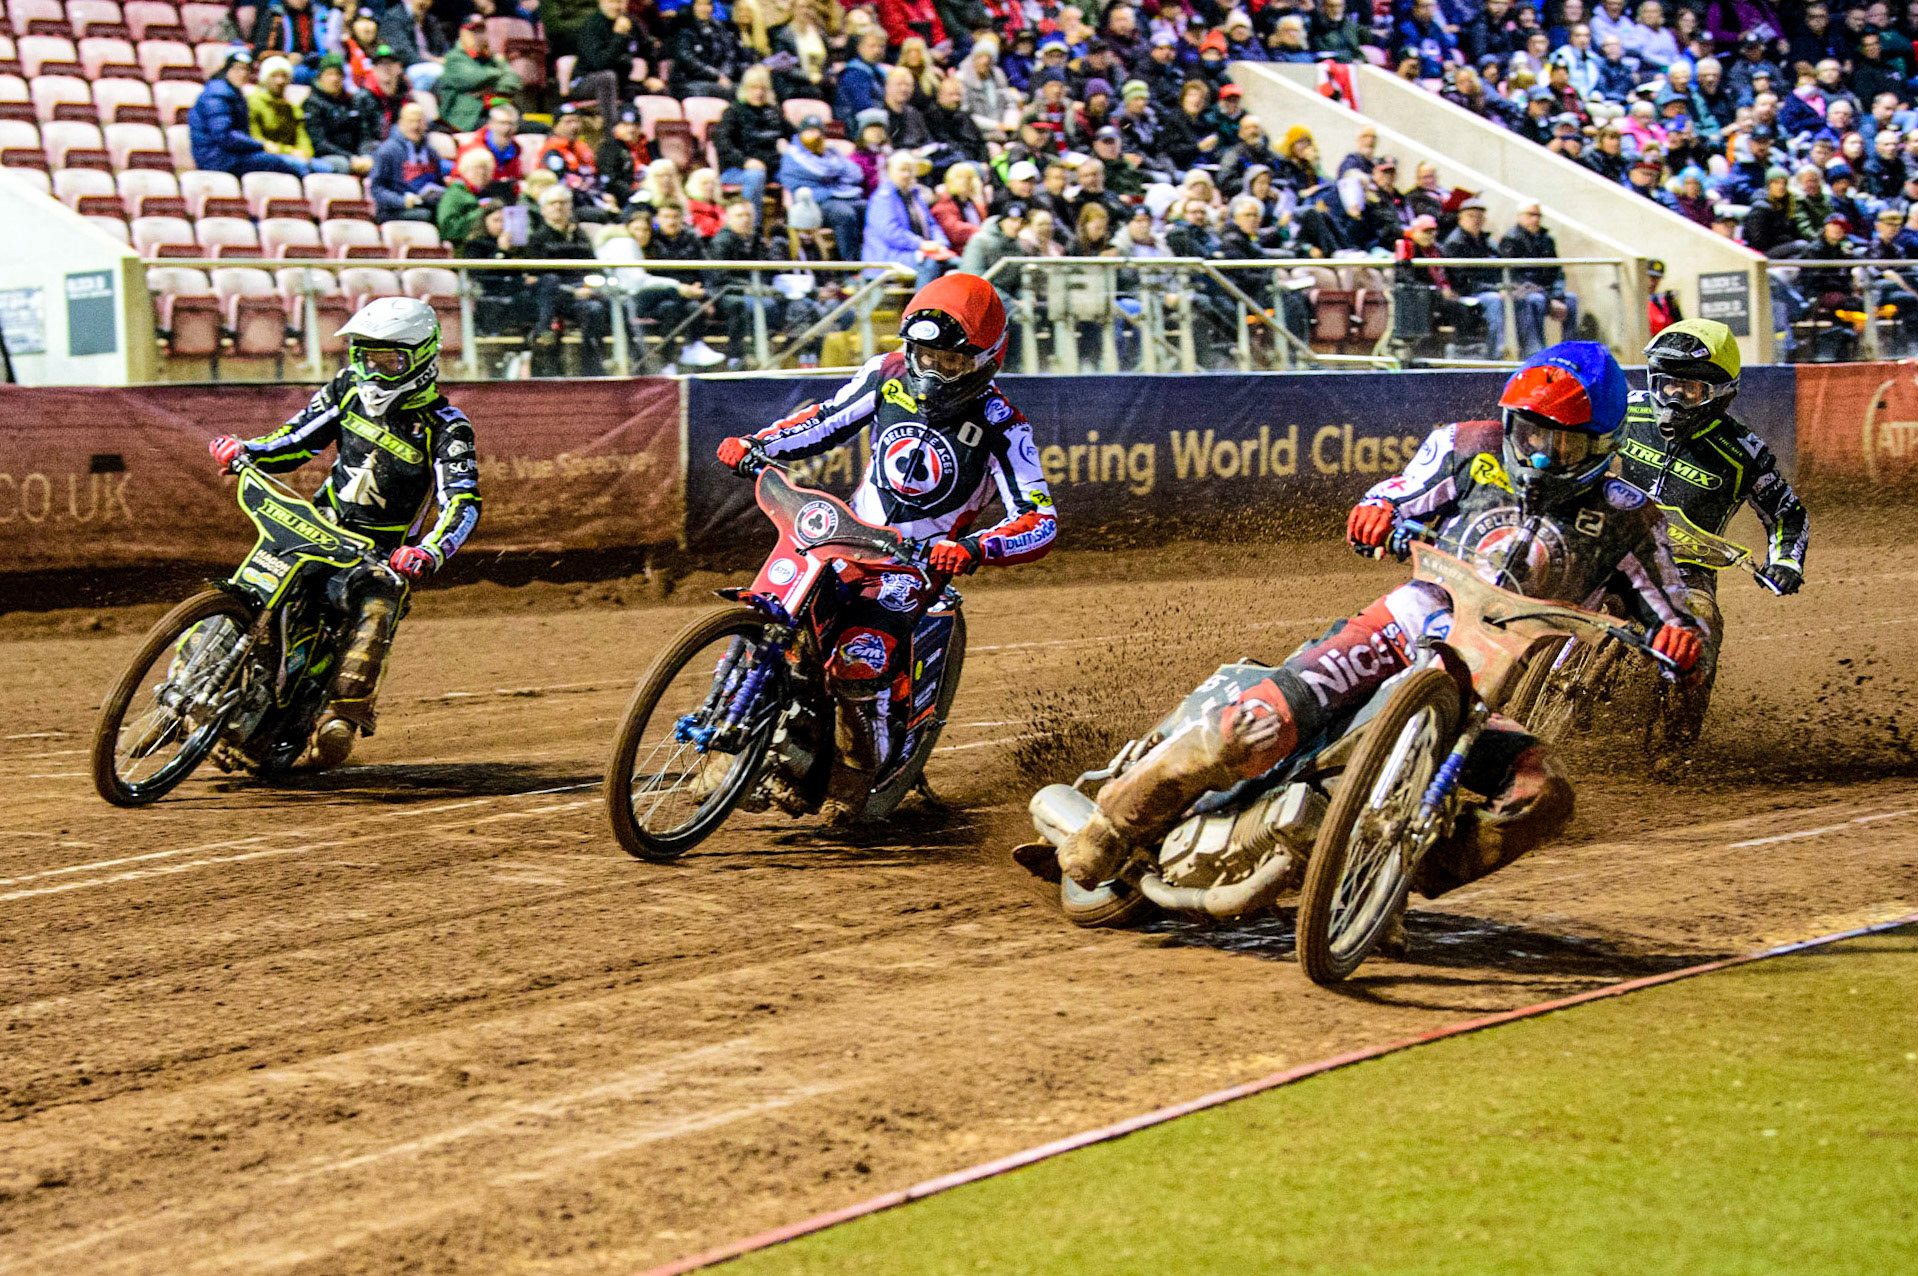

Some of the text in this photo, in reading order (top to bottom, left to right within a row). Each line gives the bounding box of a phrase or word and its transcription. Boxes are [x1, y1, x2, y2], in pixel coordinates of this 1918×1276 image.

[883, 428, 914, 446] BELLE
[937, 447, 953, 474] ACES
[1041, 430, 1155, 495] ering
[1170, 424, 1297, 479] World
[1312, 424, 1420, 474] Class
[1672, 461, 1714, 487] MIX
[264, 503, 334, 545] TRU MIX
[1475, 513, 1520, 535] BELLE
[1578, 512, 1600, 535] 2
[847, 645, 881, 659] GM
